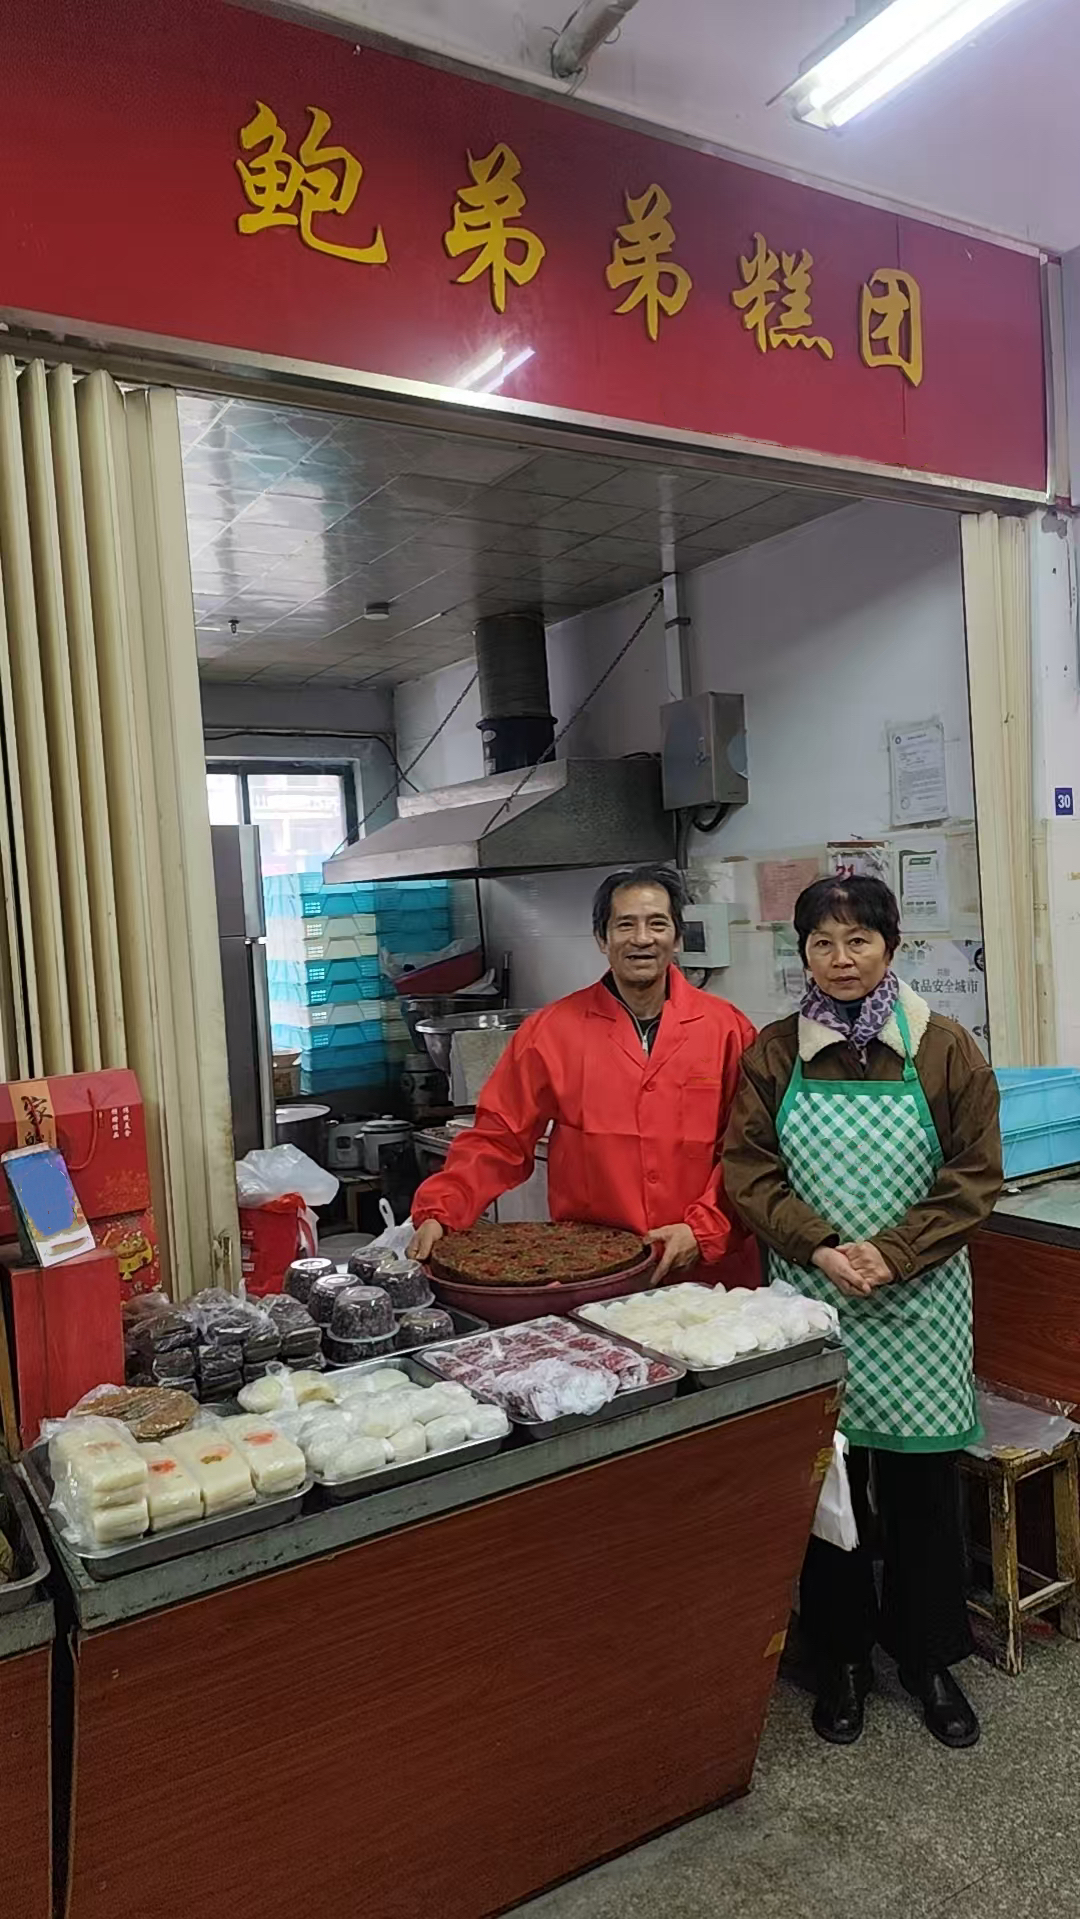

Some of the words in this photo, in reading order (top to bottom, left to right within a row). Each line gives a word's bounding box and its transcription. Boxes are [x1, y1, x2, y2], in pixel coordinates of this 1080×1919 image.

[236, 101, 923, 387] 鲍弟弟糕团
[1057, 794, 1071, 809] 30
[910, 978, 979, 994] 食品安全城市
